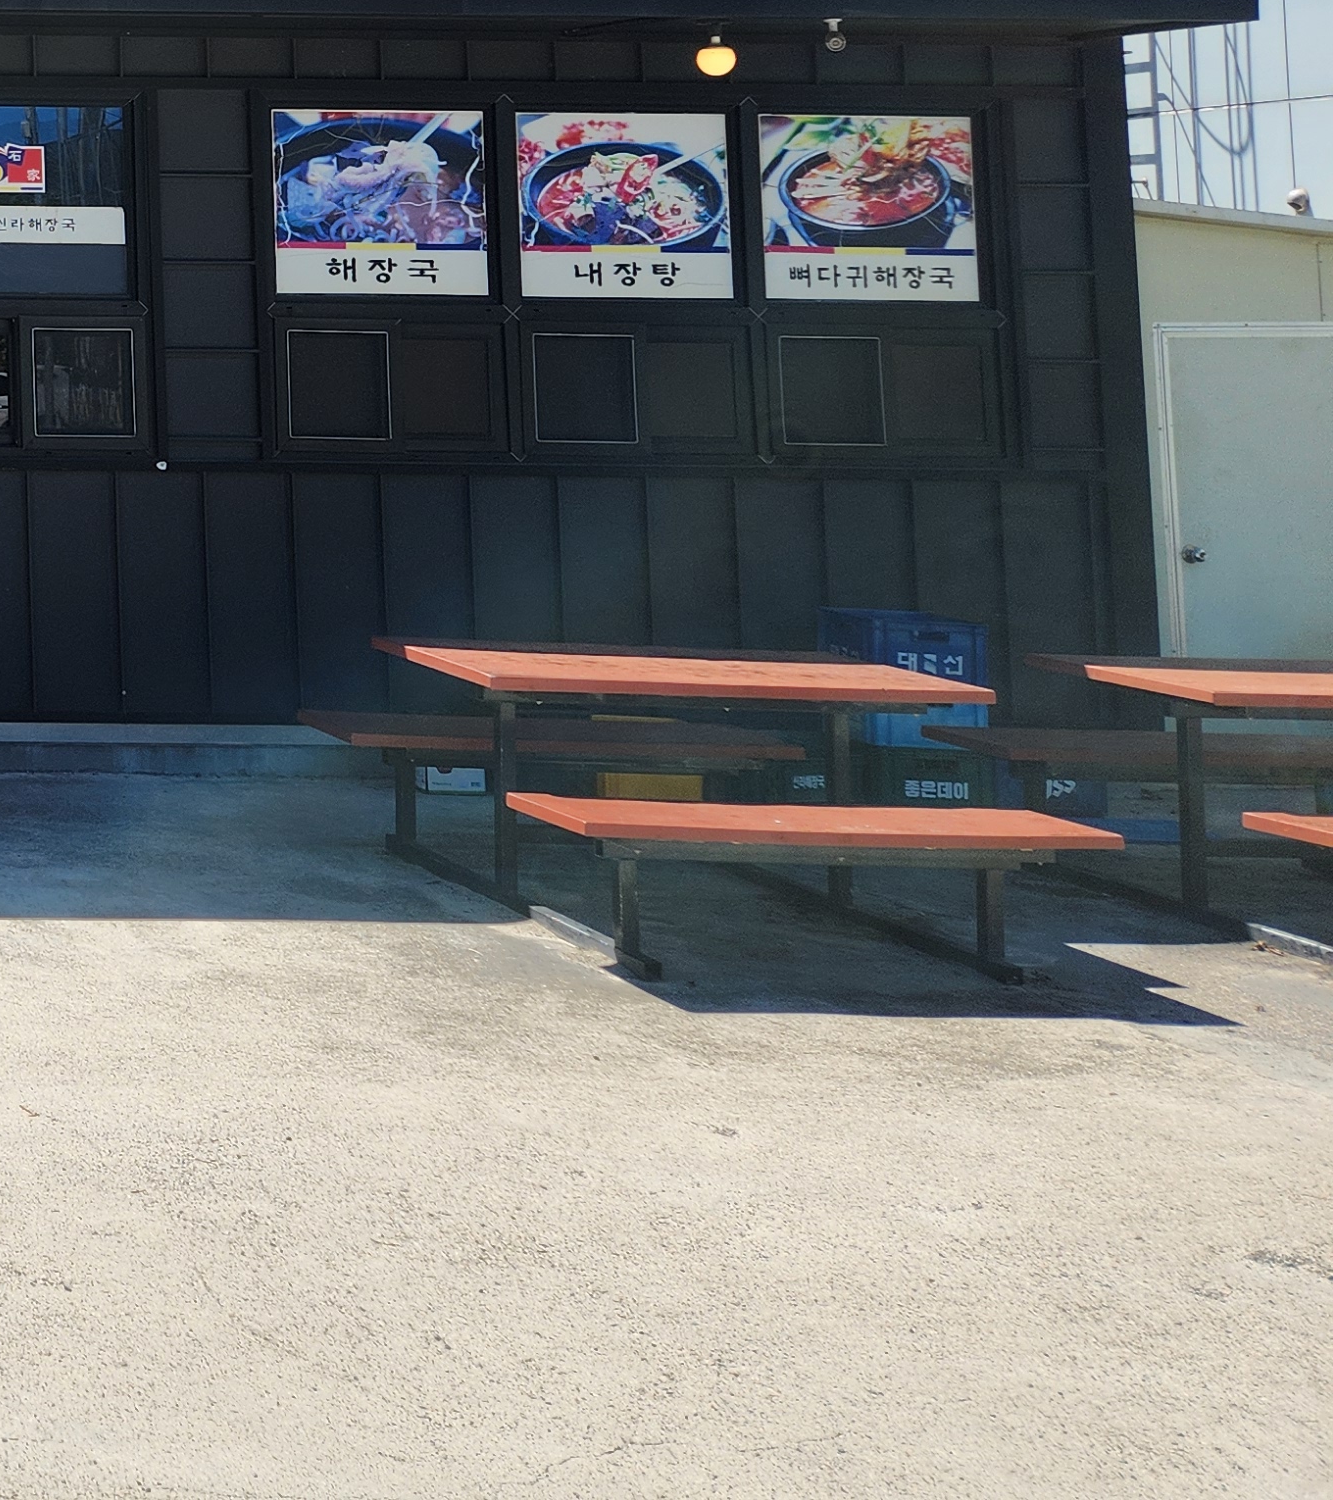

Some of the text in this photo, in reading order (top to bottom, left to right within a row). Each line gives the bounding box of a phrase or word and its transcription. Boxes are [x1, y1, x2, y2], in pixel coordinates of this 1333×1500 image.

[325, 256, 440, 284] 해장국
[573, 261, 681, 288] 내장탕
[788, 263, 955, 290] 뼈다귀해장국
[904, 779, 969, 800] 좋은데이
